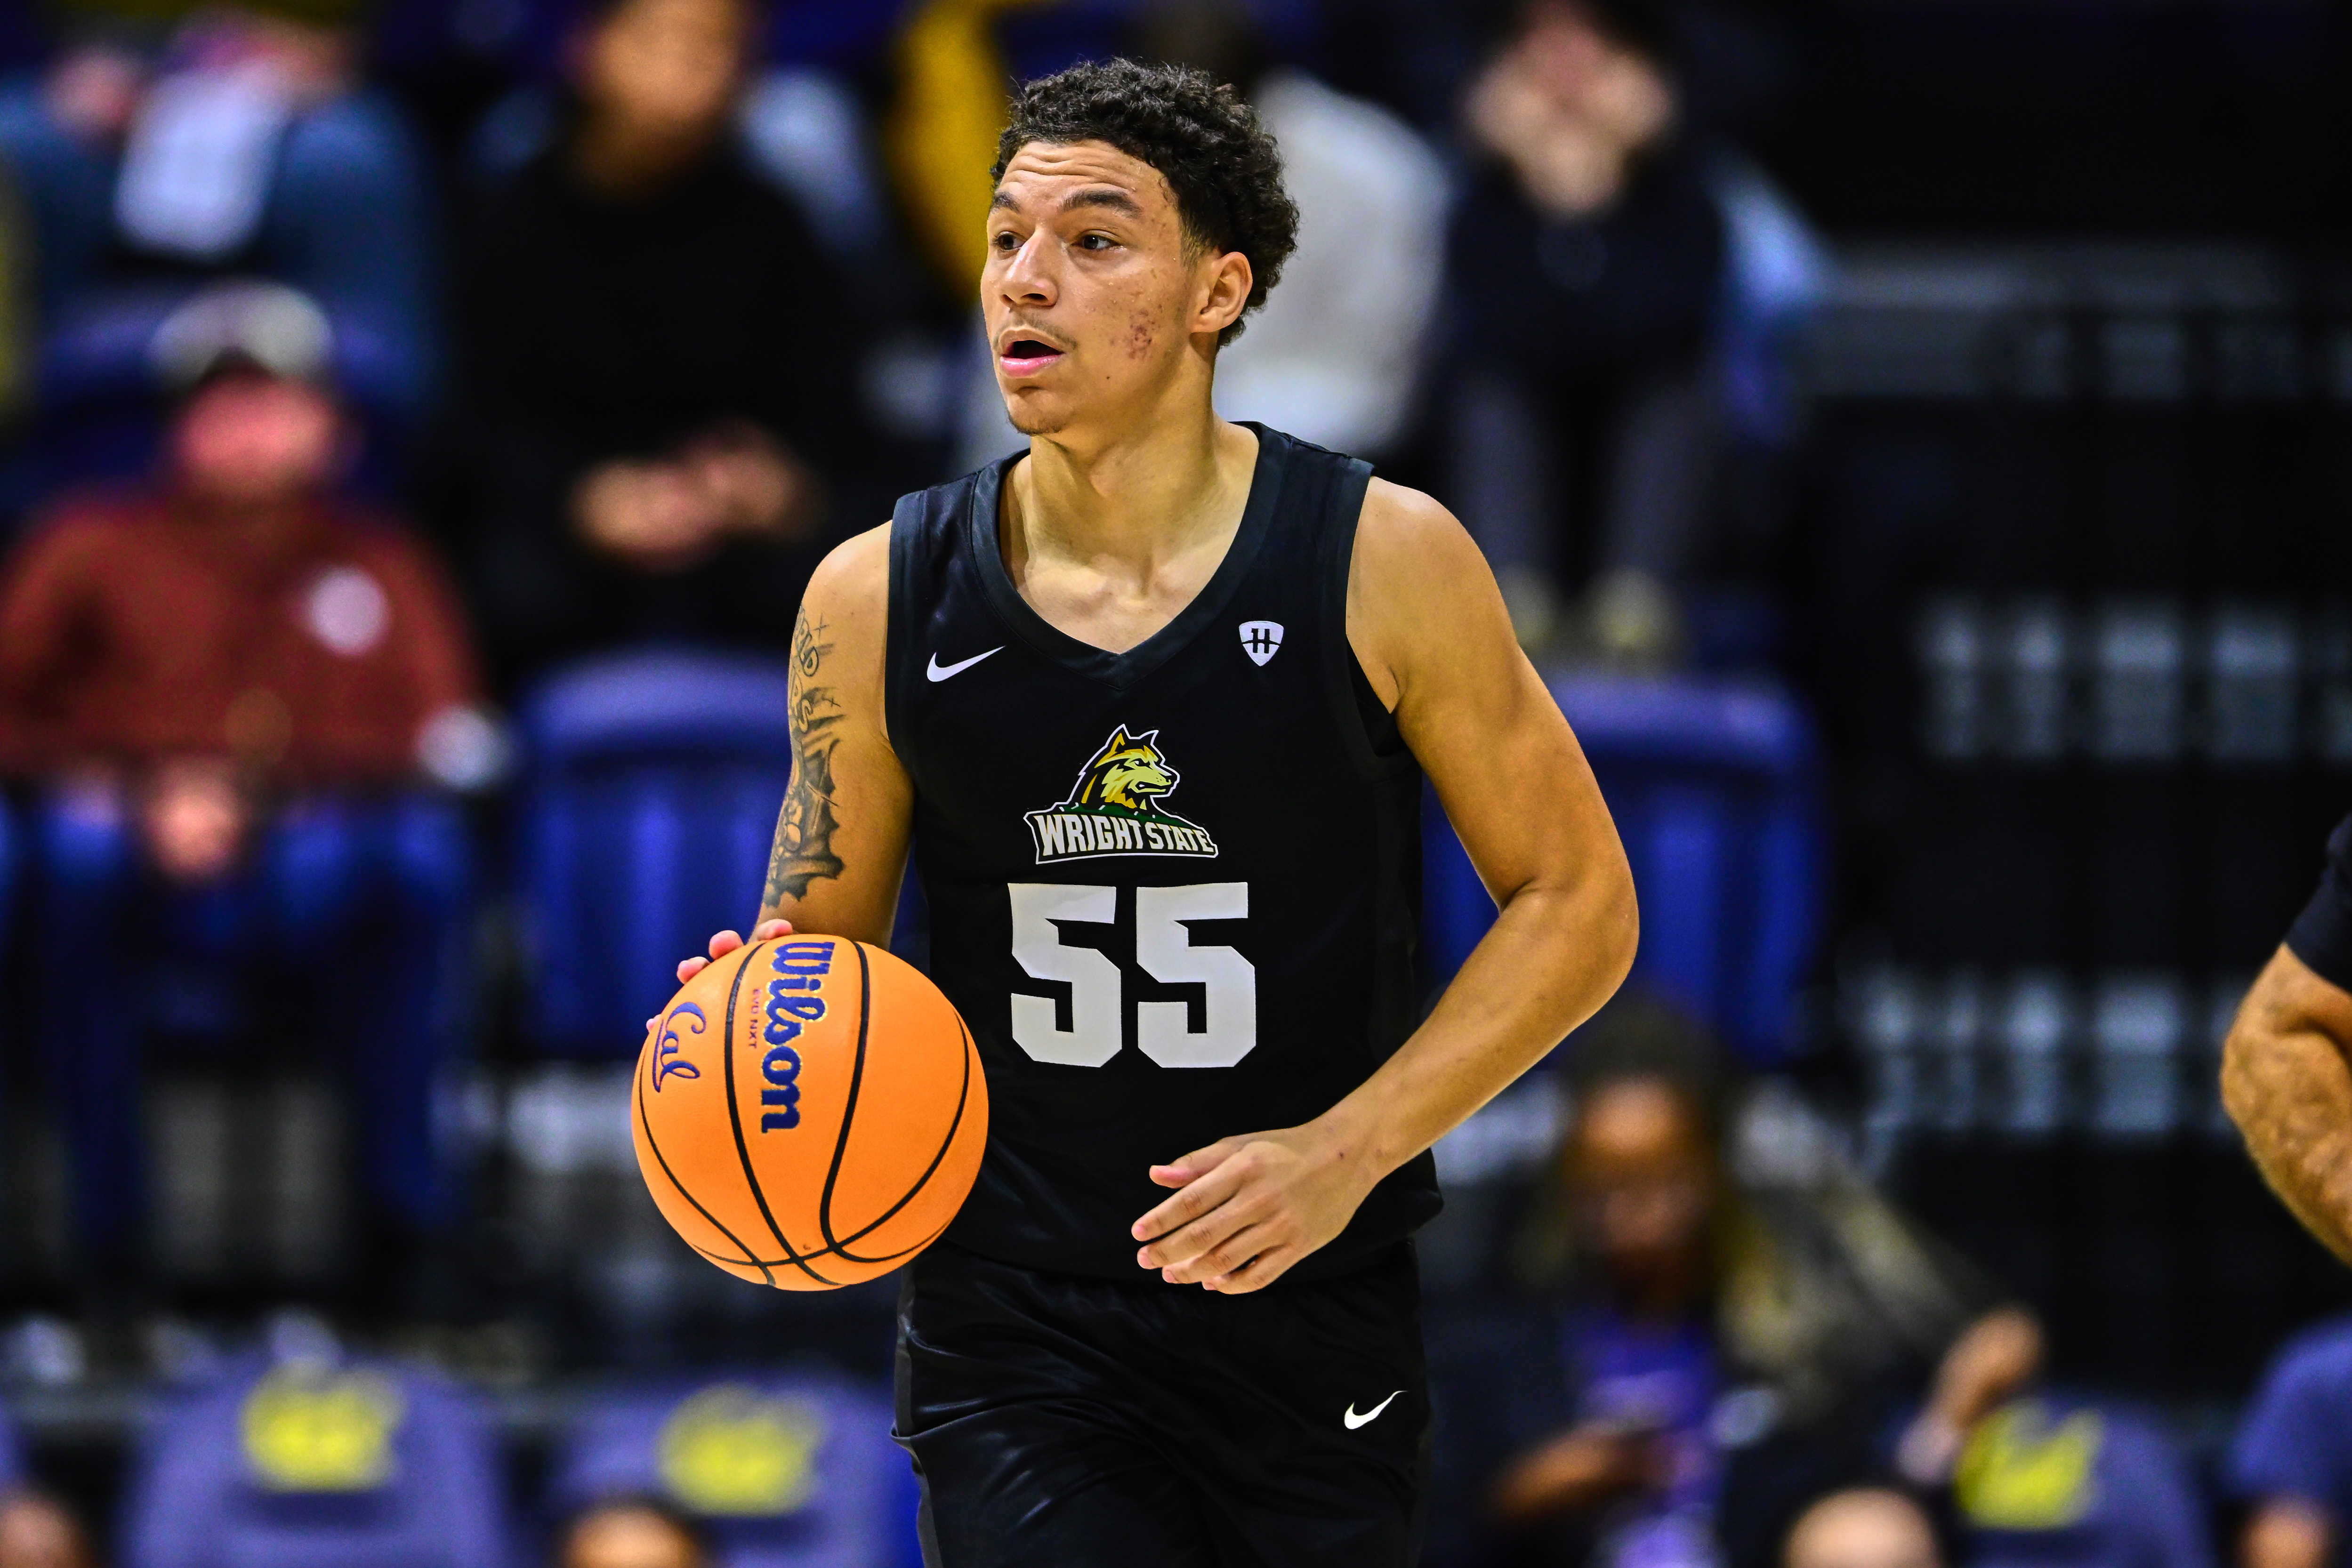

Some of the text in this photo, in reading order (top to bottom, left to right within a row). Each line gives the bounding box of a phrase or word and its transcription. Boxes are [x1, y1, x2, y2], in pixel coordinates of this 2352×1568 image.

[1033, 814, 1215, 856] WRIGHT STATE
[748, 989, 762, 1049] EVO NXT
[1007, 882, 1257, 1069] 55
[652, 1001, 707, 1093] Cal
[761, 942, 836, 1134] Wilson
